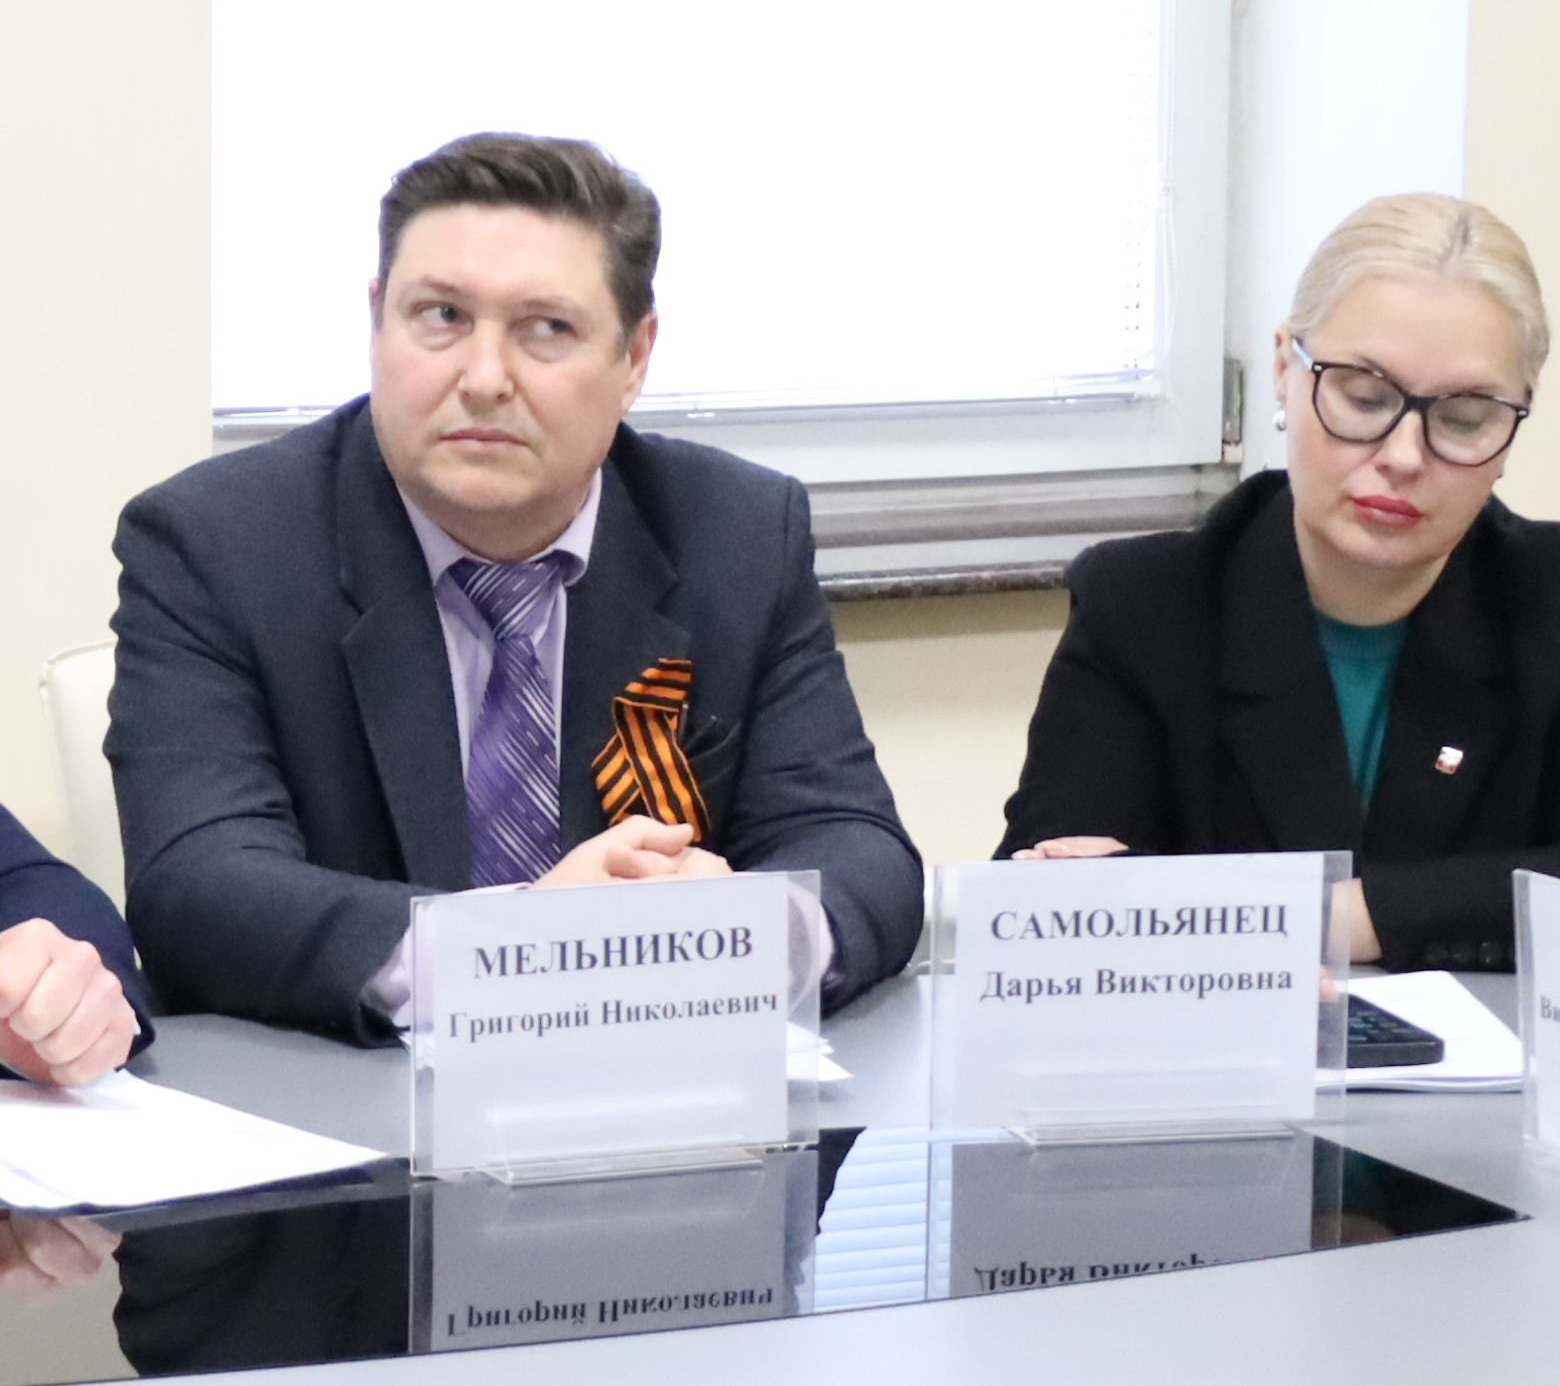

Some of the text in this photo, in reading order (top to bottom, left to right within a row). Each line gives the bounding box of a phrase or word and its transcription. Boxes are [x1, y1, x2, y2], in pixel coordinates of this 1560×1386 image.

[991, 905, 1287, 940] САМОЛЬЯНЕЦ
[473, 927, 753, 977] МЕЛЬНИКОВ
[980, 969, 1292, 1005] Дарья Викторовна
[449, 994, 777, 1044] Григорий Николаевич
